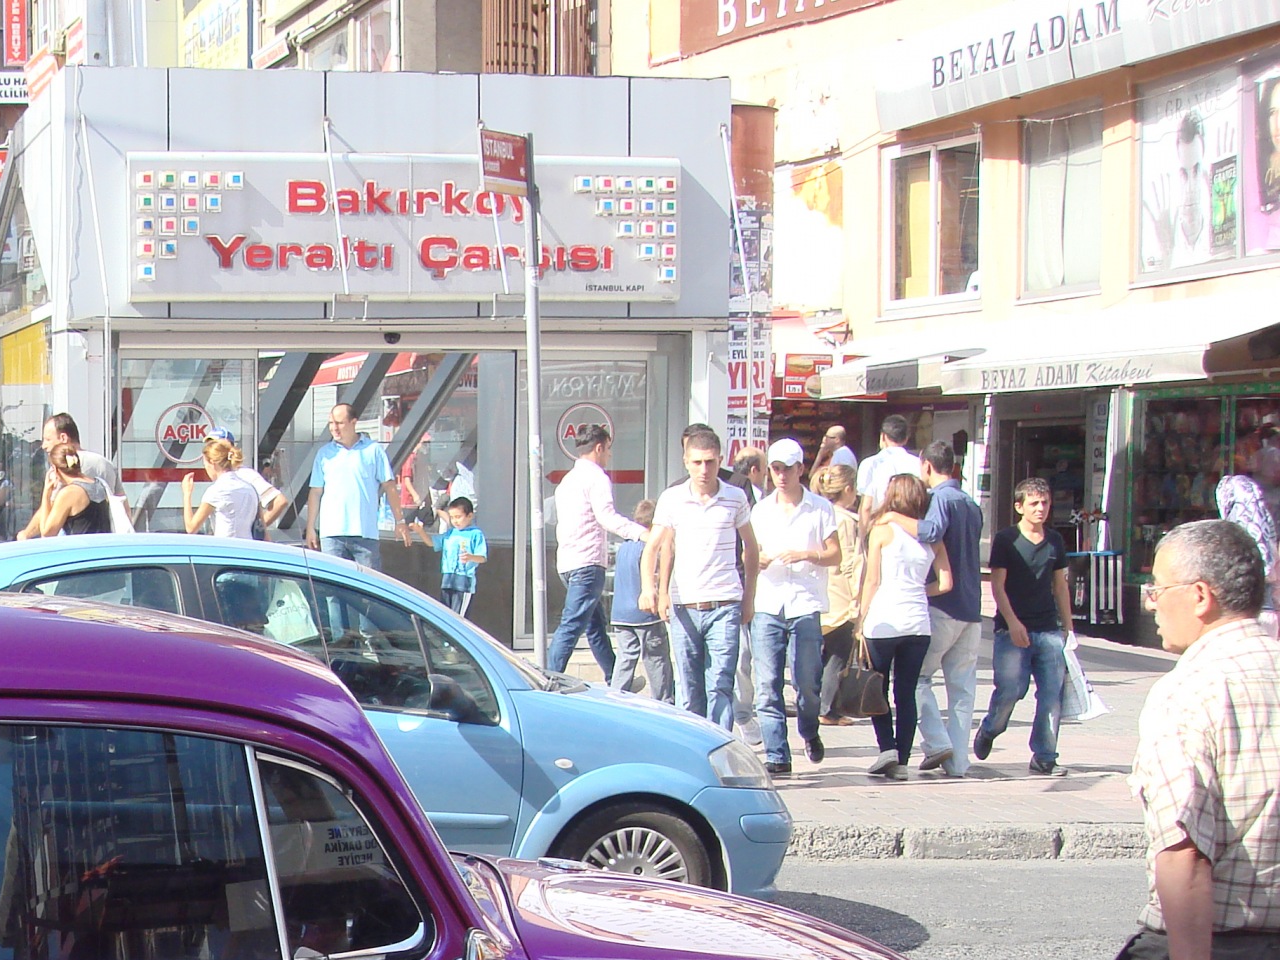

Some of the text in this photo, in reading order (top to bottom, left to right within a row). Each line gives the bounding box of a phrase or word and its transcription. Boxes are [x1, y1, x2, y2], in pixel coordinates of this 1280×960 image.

[931, 0, 1121, 89] BEYAZ ADAM
[205, 234, 394, 272] Yeraltı
[585, 283, 645, 292] İSTANBUL KAPI
[981, 359, 1153, 390] BEYAZ ADAM Kitabevi
[163, 424, 209, 444] AÇIK
